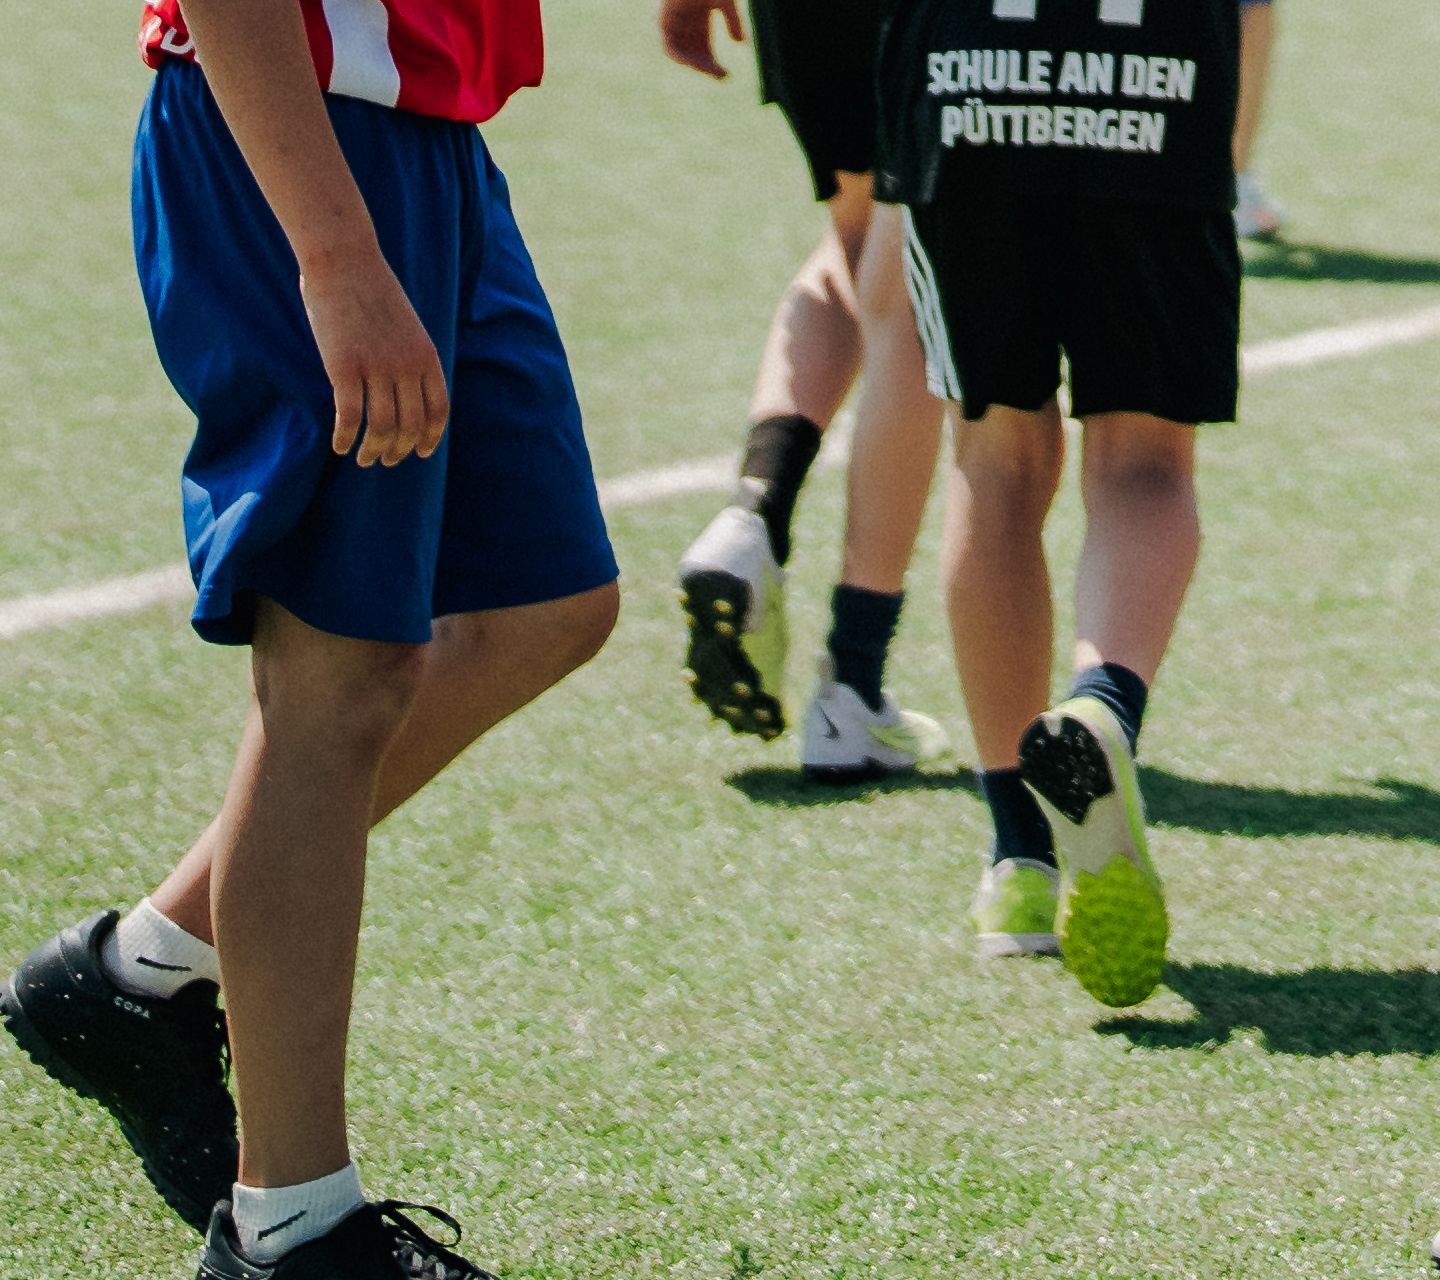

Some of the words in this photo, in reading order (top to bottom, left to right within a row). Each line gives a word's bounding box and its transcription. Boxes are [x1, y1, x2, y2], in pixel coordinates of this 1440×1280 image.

[926, 48, 1052, 96] SCHULE
[1058, 49, 1114, 97] AN
[1120, 52, 1197, 104] DEN
[940, 96, 1166, 155] PÜTTBERGEN
